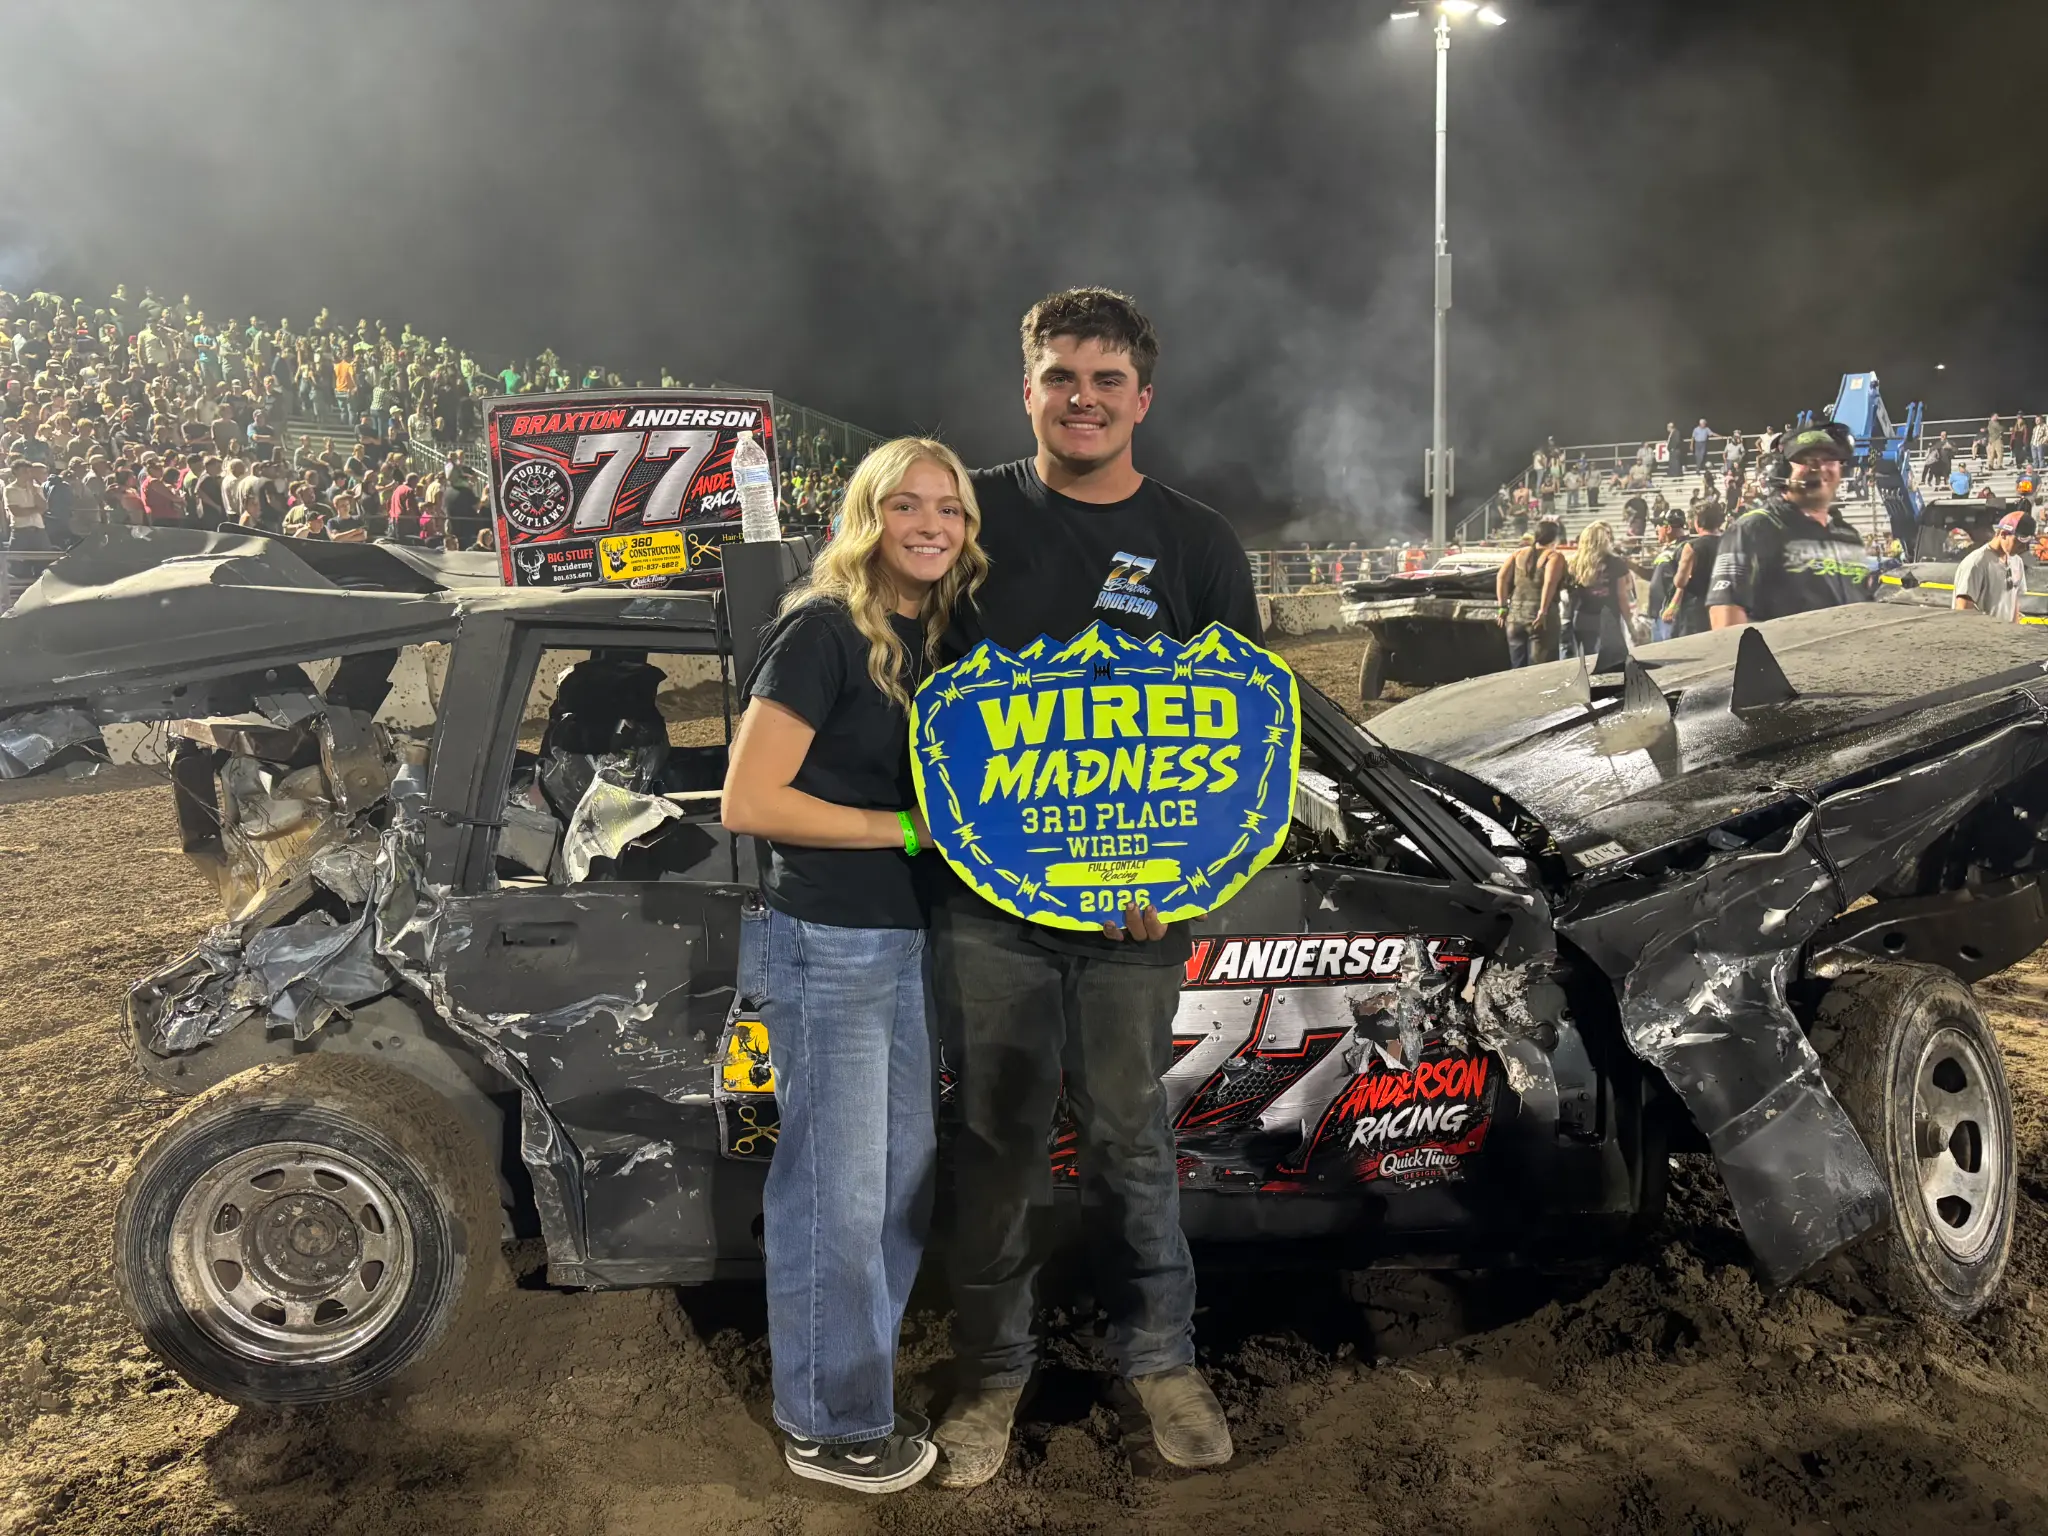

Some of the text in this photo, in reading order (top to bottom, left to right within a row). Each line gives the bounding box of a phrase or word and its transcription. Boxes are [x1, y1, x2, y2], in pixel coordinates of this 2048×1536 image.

[510, 409, 757, 436] BRAXTON ANDERSON
[512, 465, 557, 483] TOOELE
[572, 430, 719, 531] 77
[691, 471, 735, 500] ANDE
[512, 504, 565, 527] OUTLAWS
[629, 544, 681, 558] CONSTRUCTION
[631, 536, 653, 549] 360
[547, 548, 594, 563] BIG STUFF
[552, 562, 593, 572] Taxidermy
[1104, 551, 1157, 586] 77
[1093, 590, 1158, 620] ANDERSON
[977, 684, 1239, 751] WIRED
[978, 743, 1241, 805] MADNESS
[1021, 800, 1198, 833] 3RD PLACE
[1067, 834, 1149, 858] WIRED
[1088, 860, 1148, 872] FULL CONTACT
[1100, 869, 1138, 883] Racing
[1080, 889, 1151, 912] 2026
[1338, 1056, 1489, 1123] ANDERSON
[1348, 1102, 1468, 1151] RACING
[1380, 1147, 1459, 1175] Quick Time
[1403, 1170, 1441, 1180] DESIGNS
